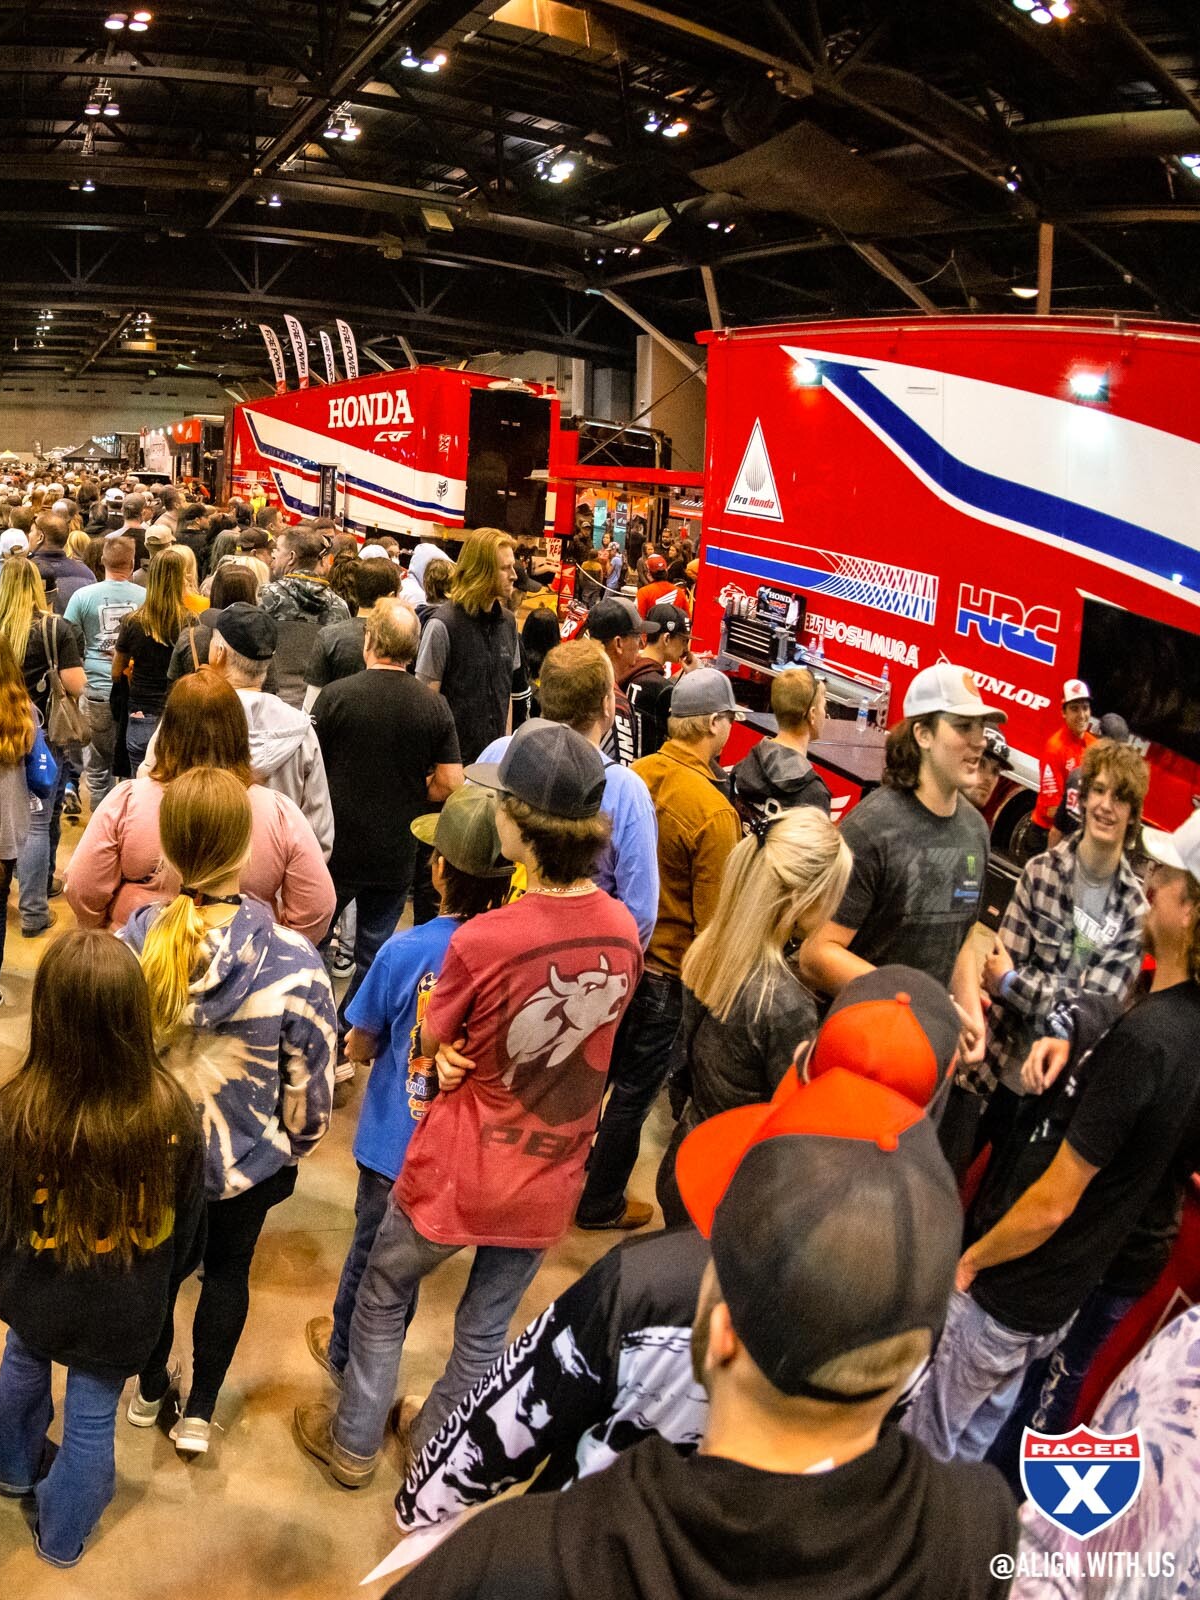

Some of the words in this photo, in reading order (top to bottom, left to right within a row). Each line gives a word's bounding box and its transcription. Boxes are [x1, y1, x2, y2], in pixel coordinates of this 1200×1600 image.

[341, 325, 351, 345] FIRE
[346, 346, 356, 378] POWER
[328, 389, 415, 428] HONDA
[374, 430, 412, 442] CRF
[733, 494, 748, 505] Pro
[748, 496, 774, 509] Honda
[768, 591, 791, 604] HOND
[824, 617, 920, 669] YOSHIMURA
[955, 582, 1061, 667] HRC
[972, 671, 1051, 711] UNLOP
